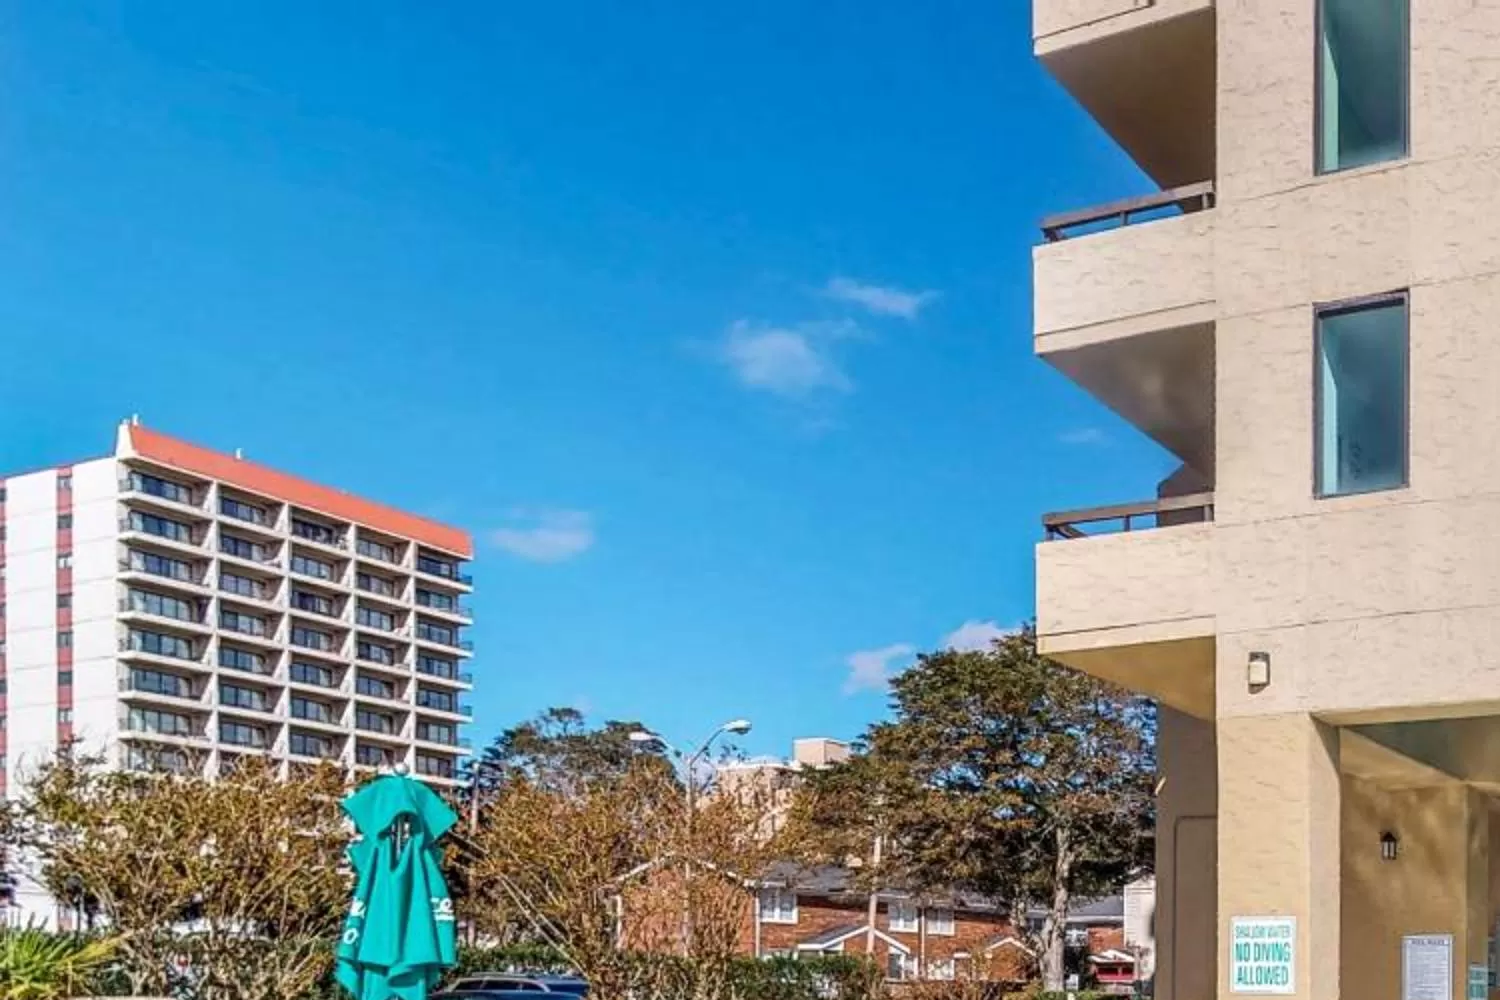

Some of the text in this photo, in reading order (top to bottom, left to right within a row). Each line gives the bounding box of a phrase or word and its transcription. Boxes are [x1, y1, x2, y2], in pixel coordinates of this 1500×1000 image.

[1235, 942, 1291, 962] NO DIVING
[1236, 965, 1289, 985] ALLOWED
